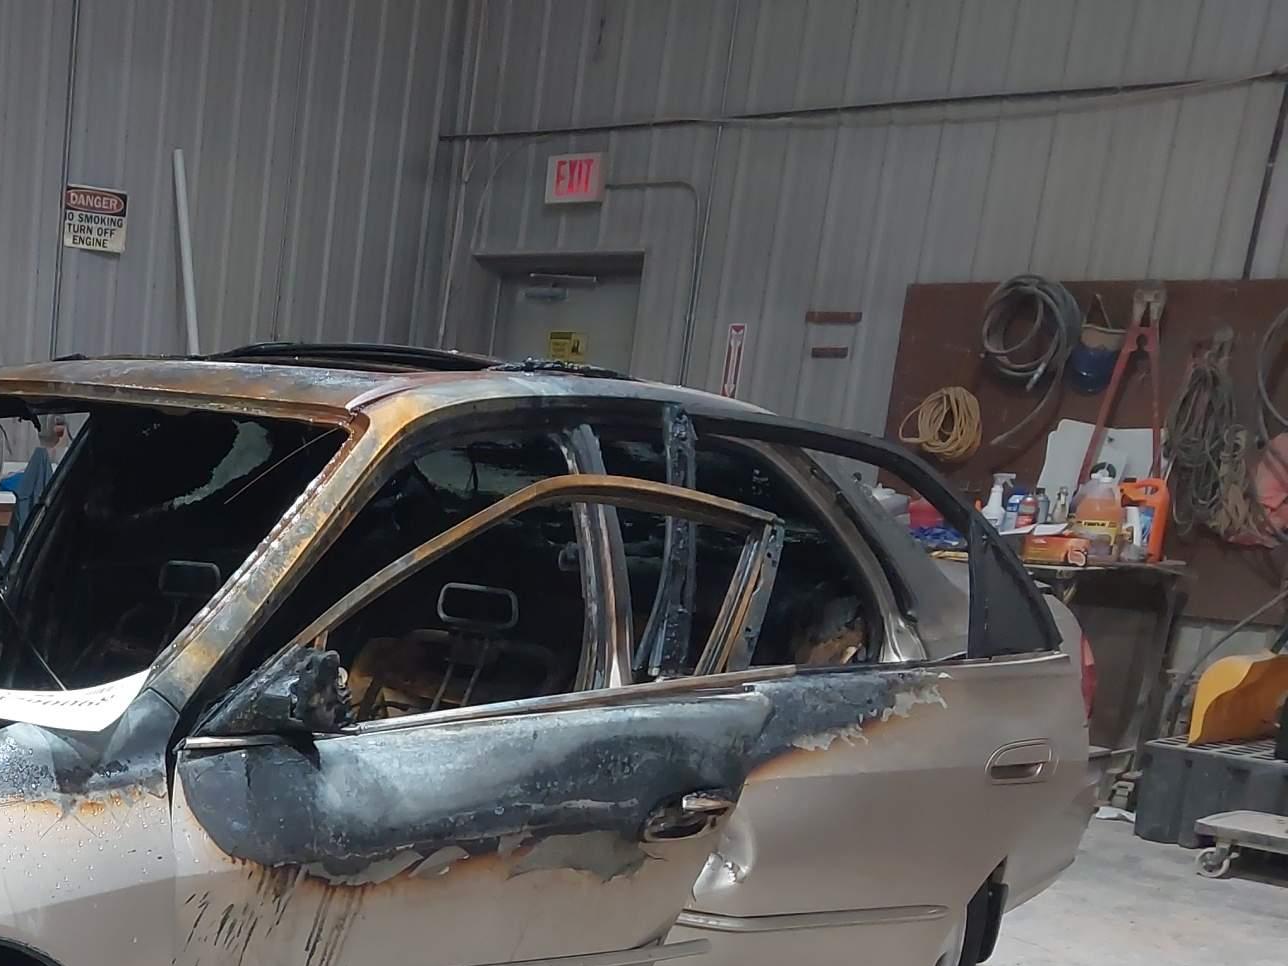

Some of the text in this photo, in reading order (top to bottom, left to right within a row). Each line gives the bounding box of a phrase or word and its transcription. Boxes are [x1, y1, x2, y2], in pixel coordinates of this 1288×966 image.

[555, 159, 594, 195] EXIT
[70, 192, 118, 210] DANGER
[78, 213, 124, 228] SMOKING
[67, 223, 117, 238] TURN OFF
[72, 234, 109, 248] ENGINE
